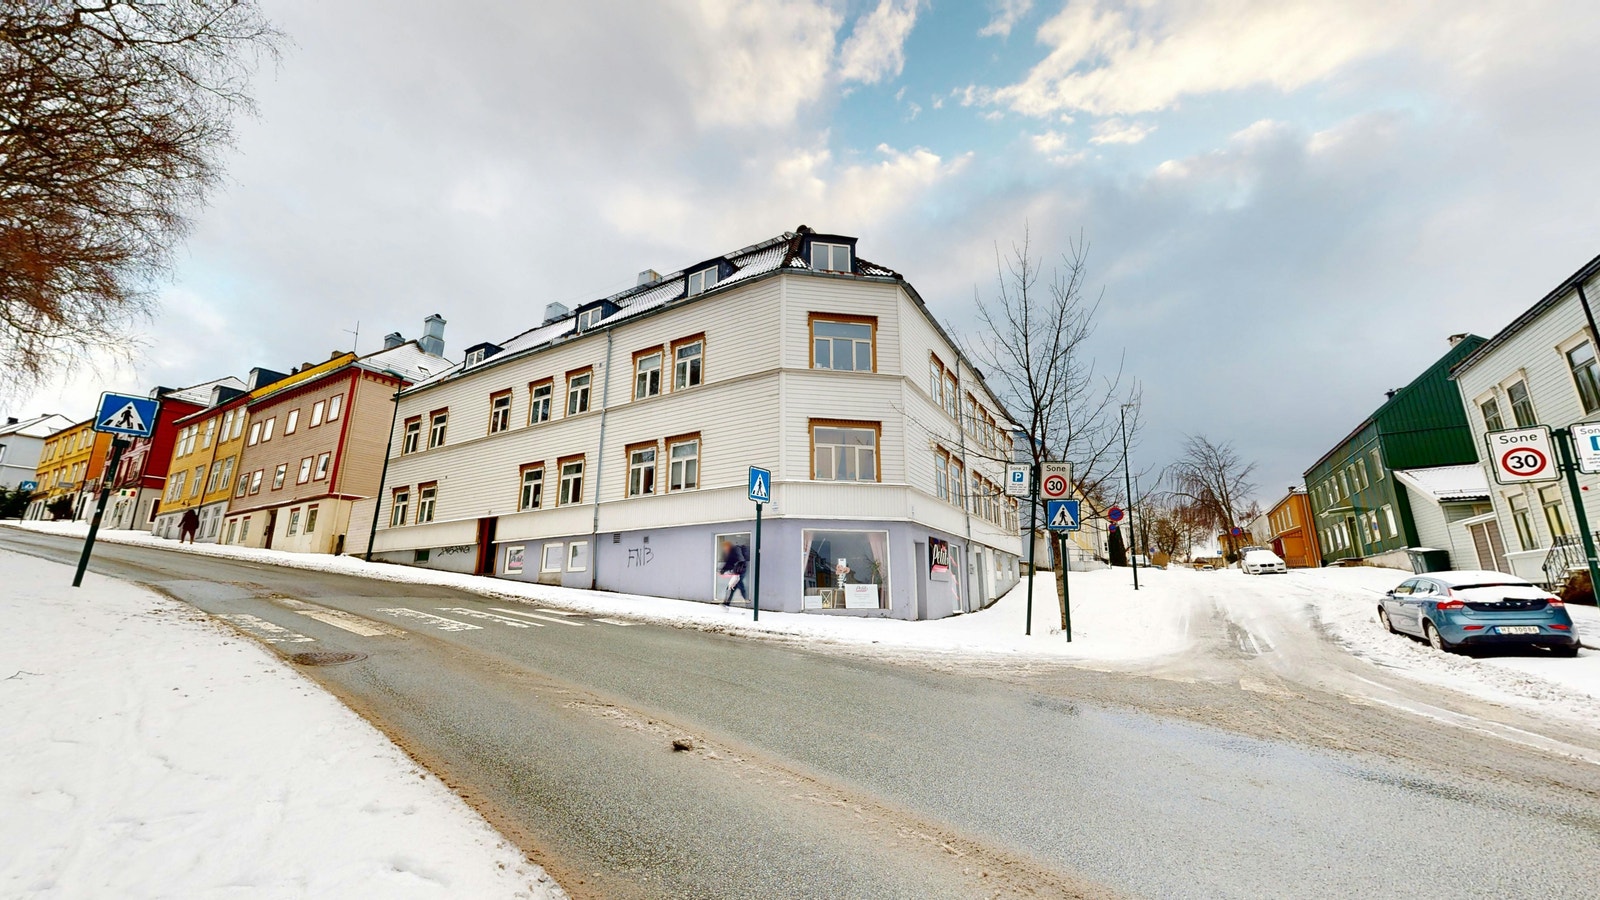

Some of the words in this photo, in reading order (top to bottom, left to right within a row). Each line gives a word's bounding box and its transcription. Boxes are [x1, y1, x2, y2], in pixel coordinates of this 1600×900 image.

[1499, 433, 1538, 445] Sone
[1046, 464, 1066, 472] Sone
[1509, 454, 1538, 470] 30
[1015, 472, 1022, 482] P
[1048, 480, 1063, 492] 30
